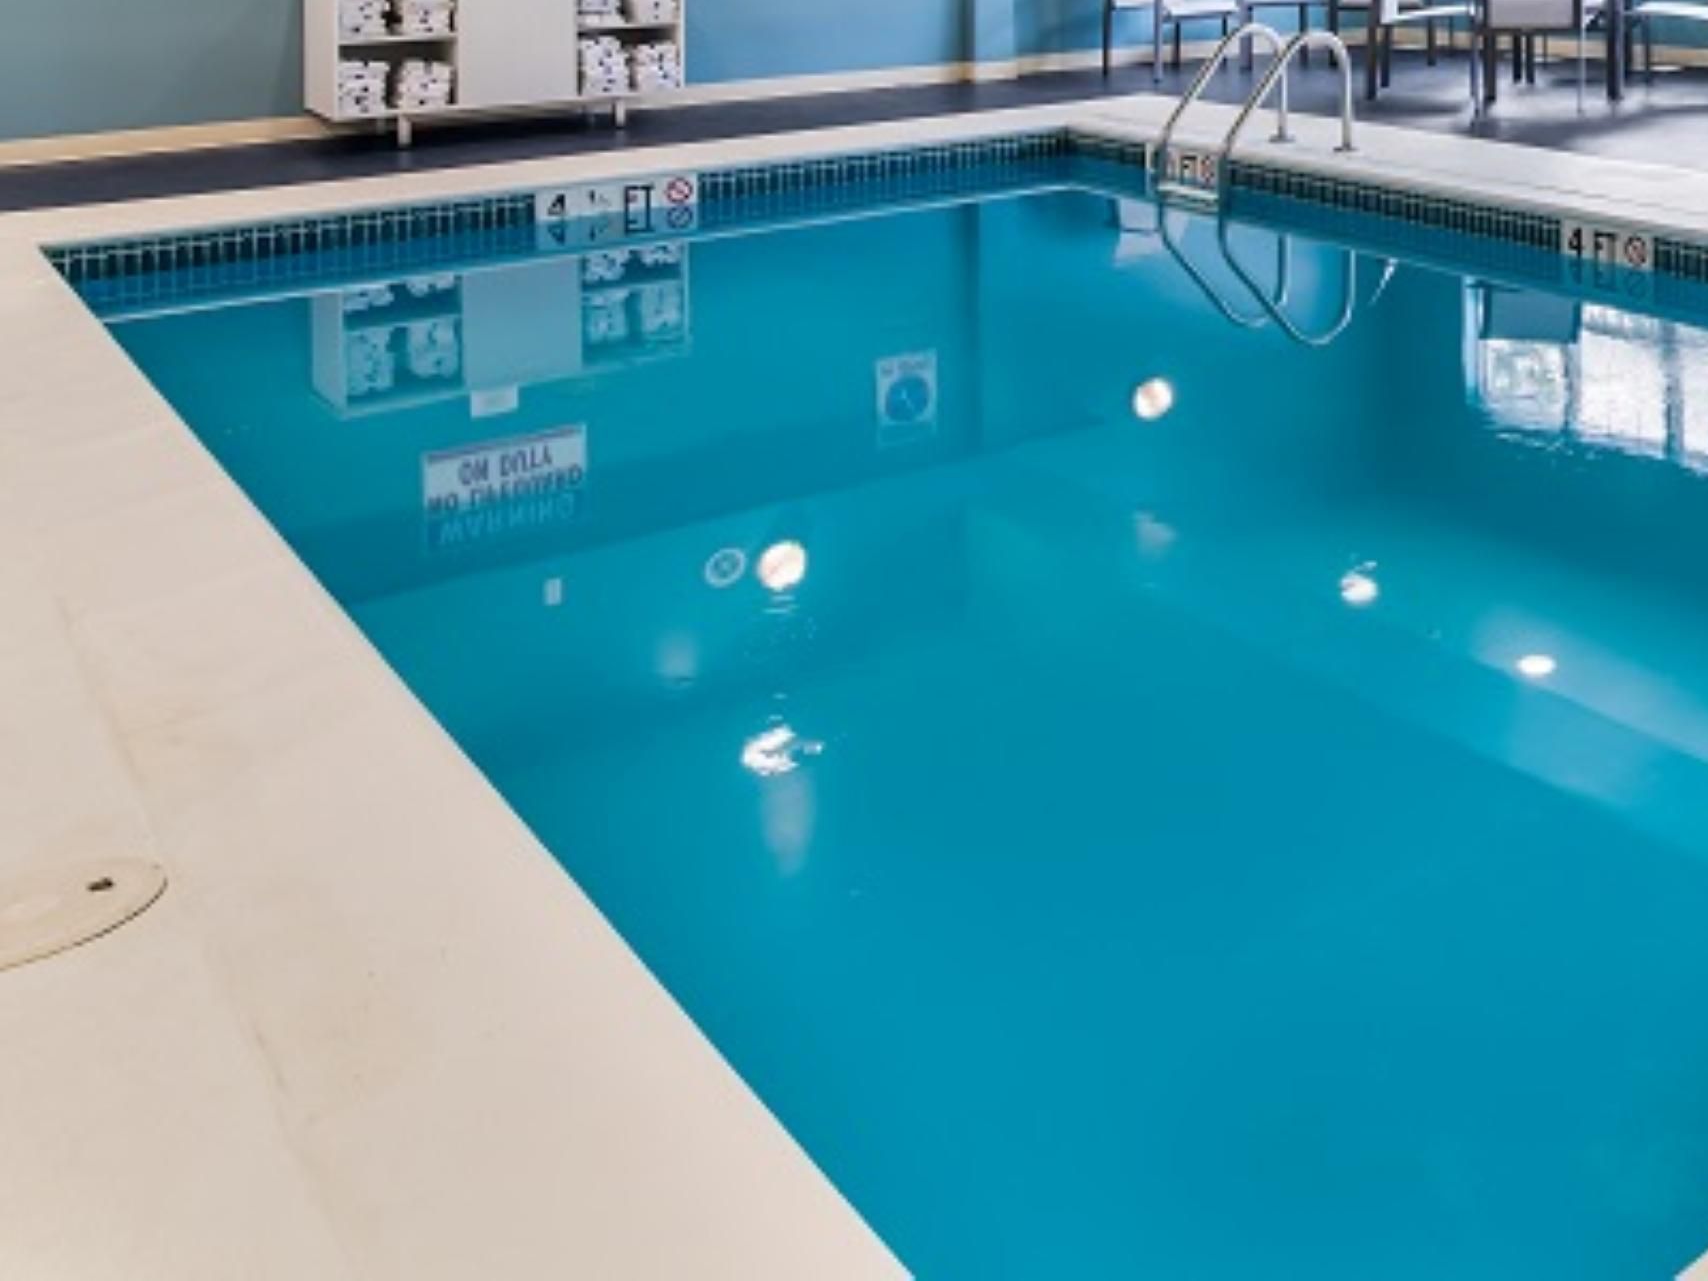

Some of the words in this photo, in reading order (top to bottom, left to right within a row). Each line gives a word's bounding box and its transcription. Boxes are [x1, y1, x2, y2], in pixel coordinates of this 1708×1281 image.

[547, 193, 567, 216] 4
[624, 184, 655, 213] FT
[1568, 227, 1583, 255] 4
[1593, 230, 1618, 263] FT
